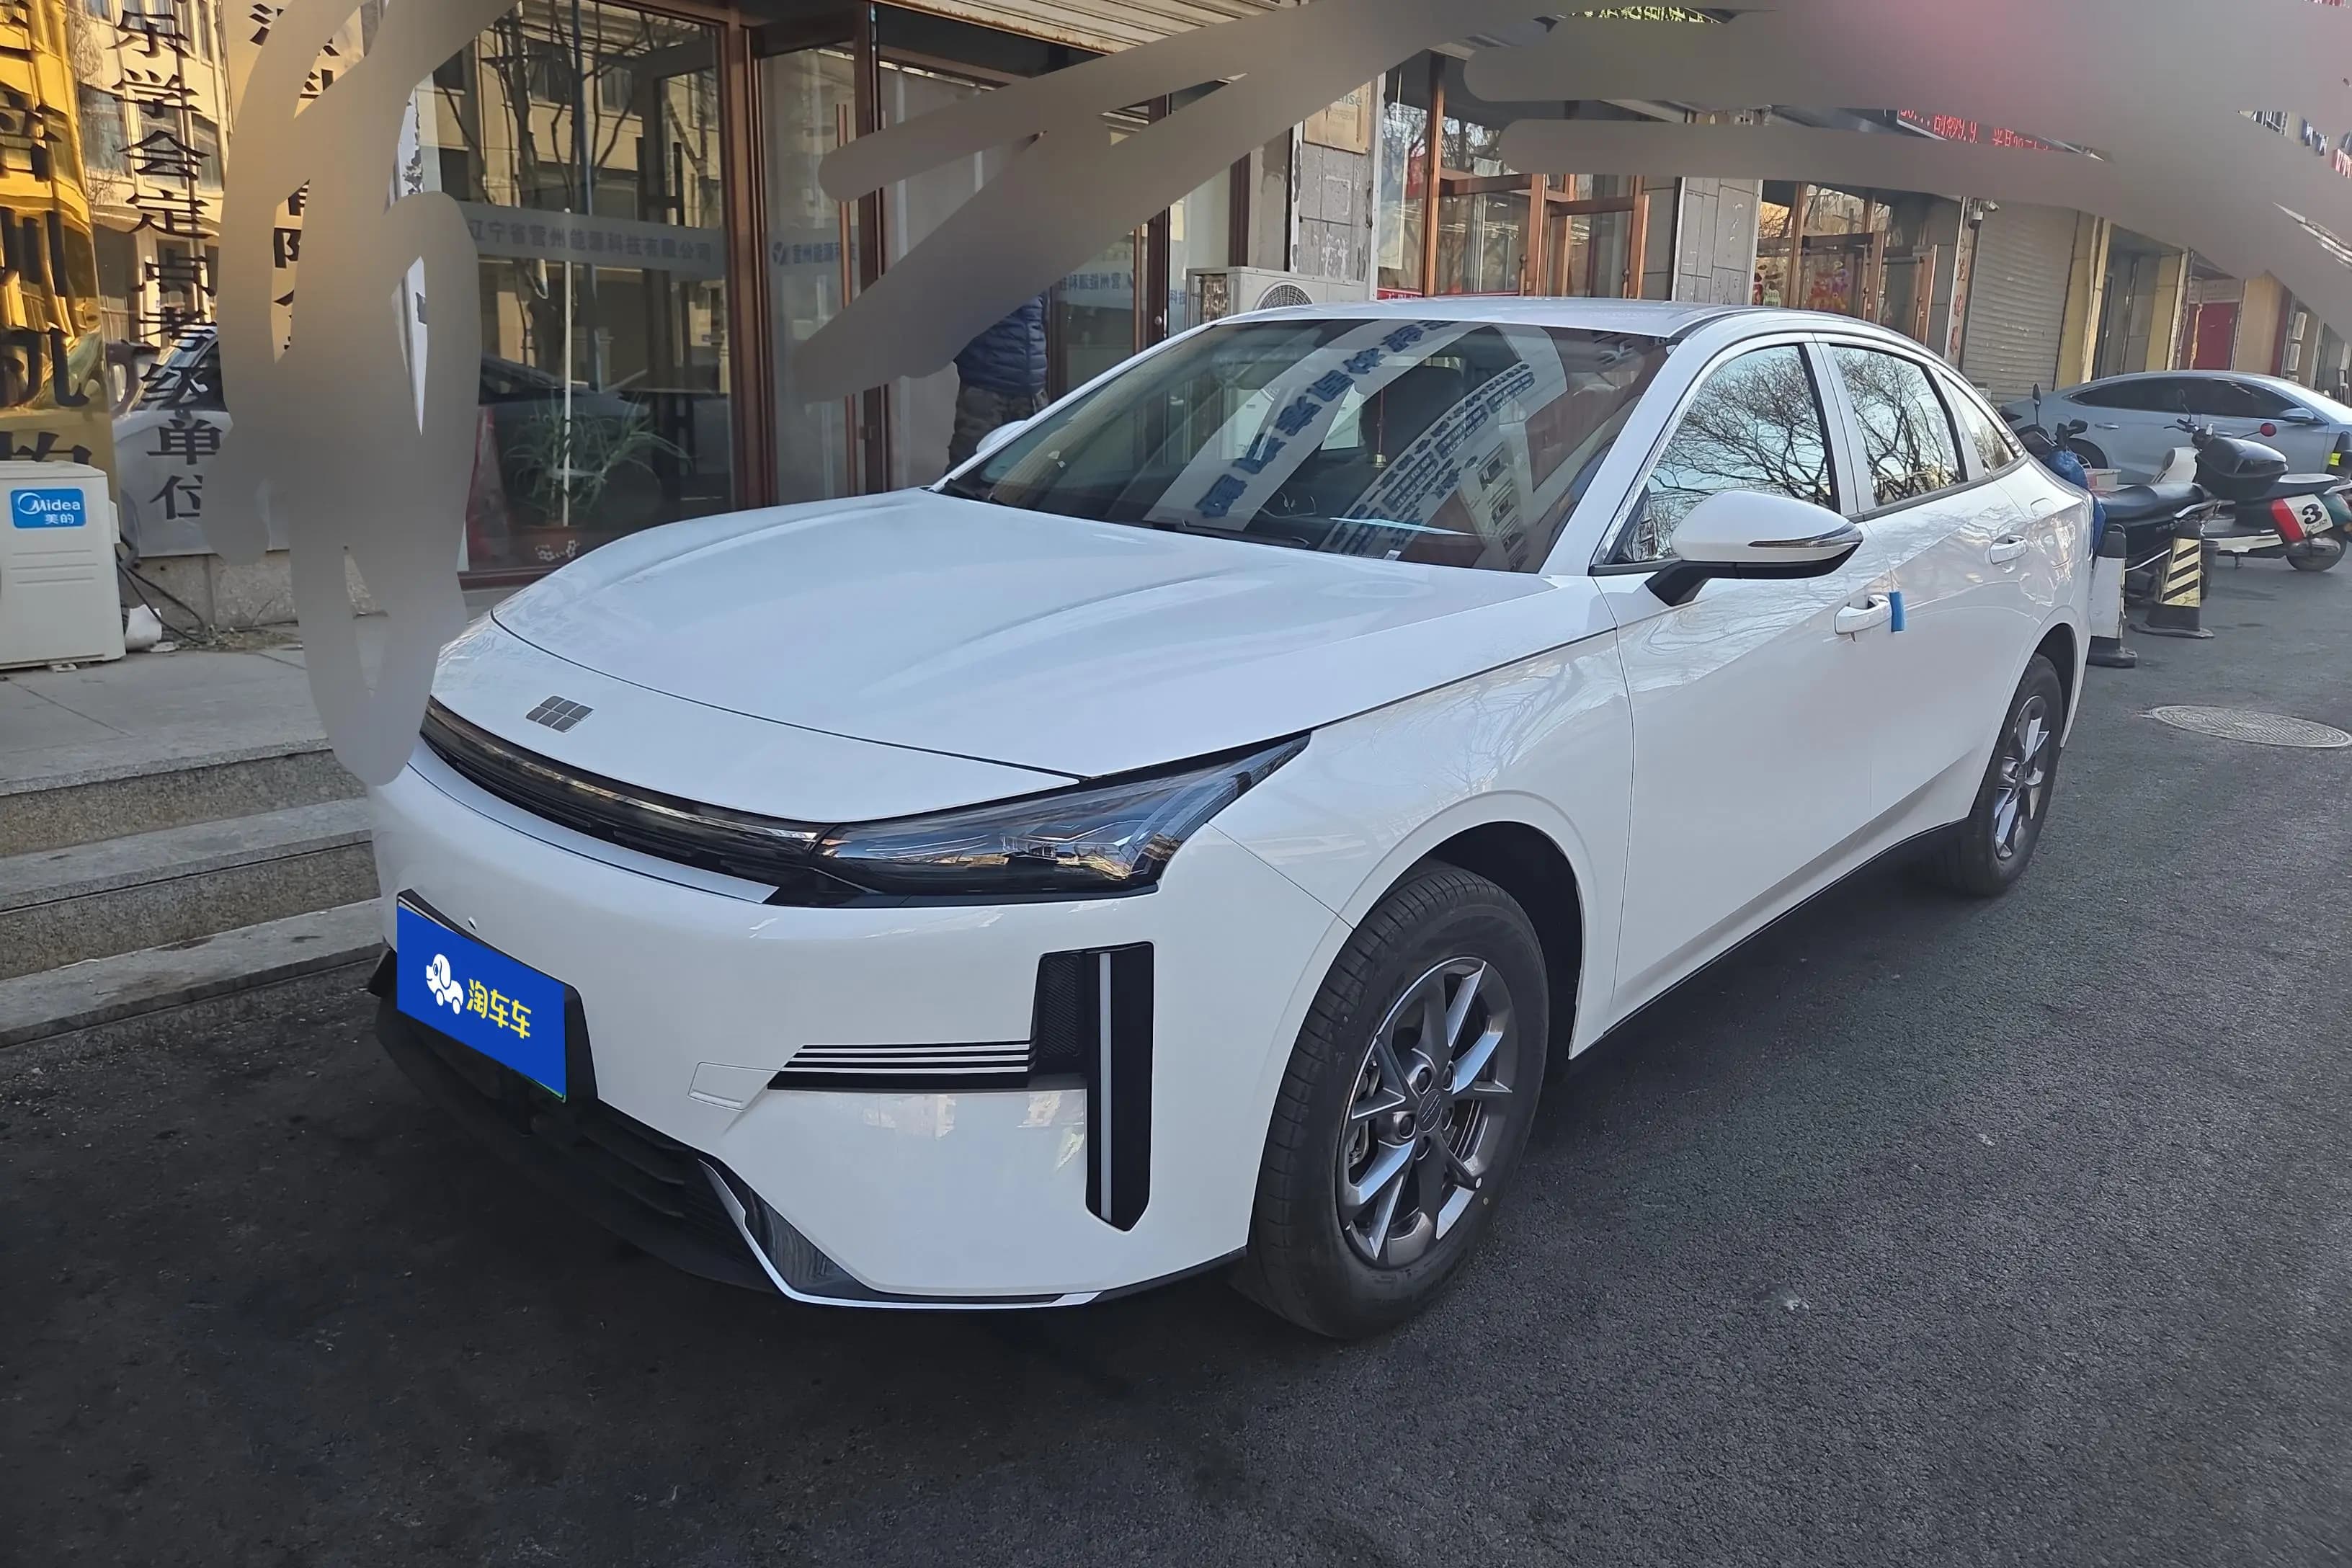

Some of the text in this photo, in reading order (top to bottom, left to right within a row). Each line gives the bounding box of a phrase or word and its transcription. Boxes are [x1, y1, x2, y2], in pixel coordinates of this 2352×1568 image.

[22, 496, 81, 512] Midea
[45, 513, 74, 525] 美的
[2302, 503, 2323, 525] 3
